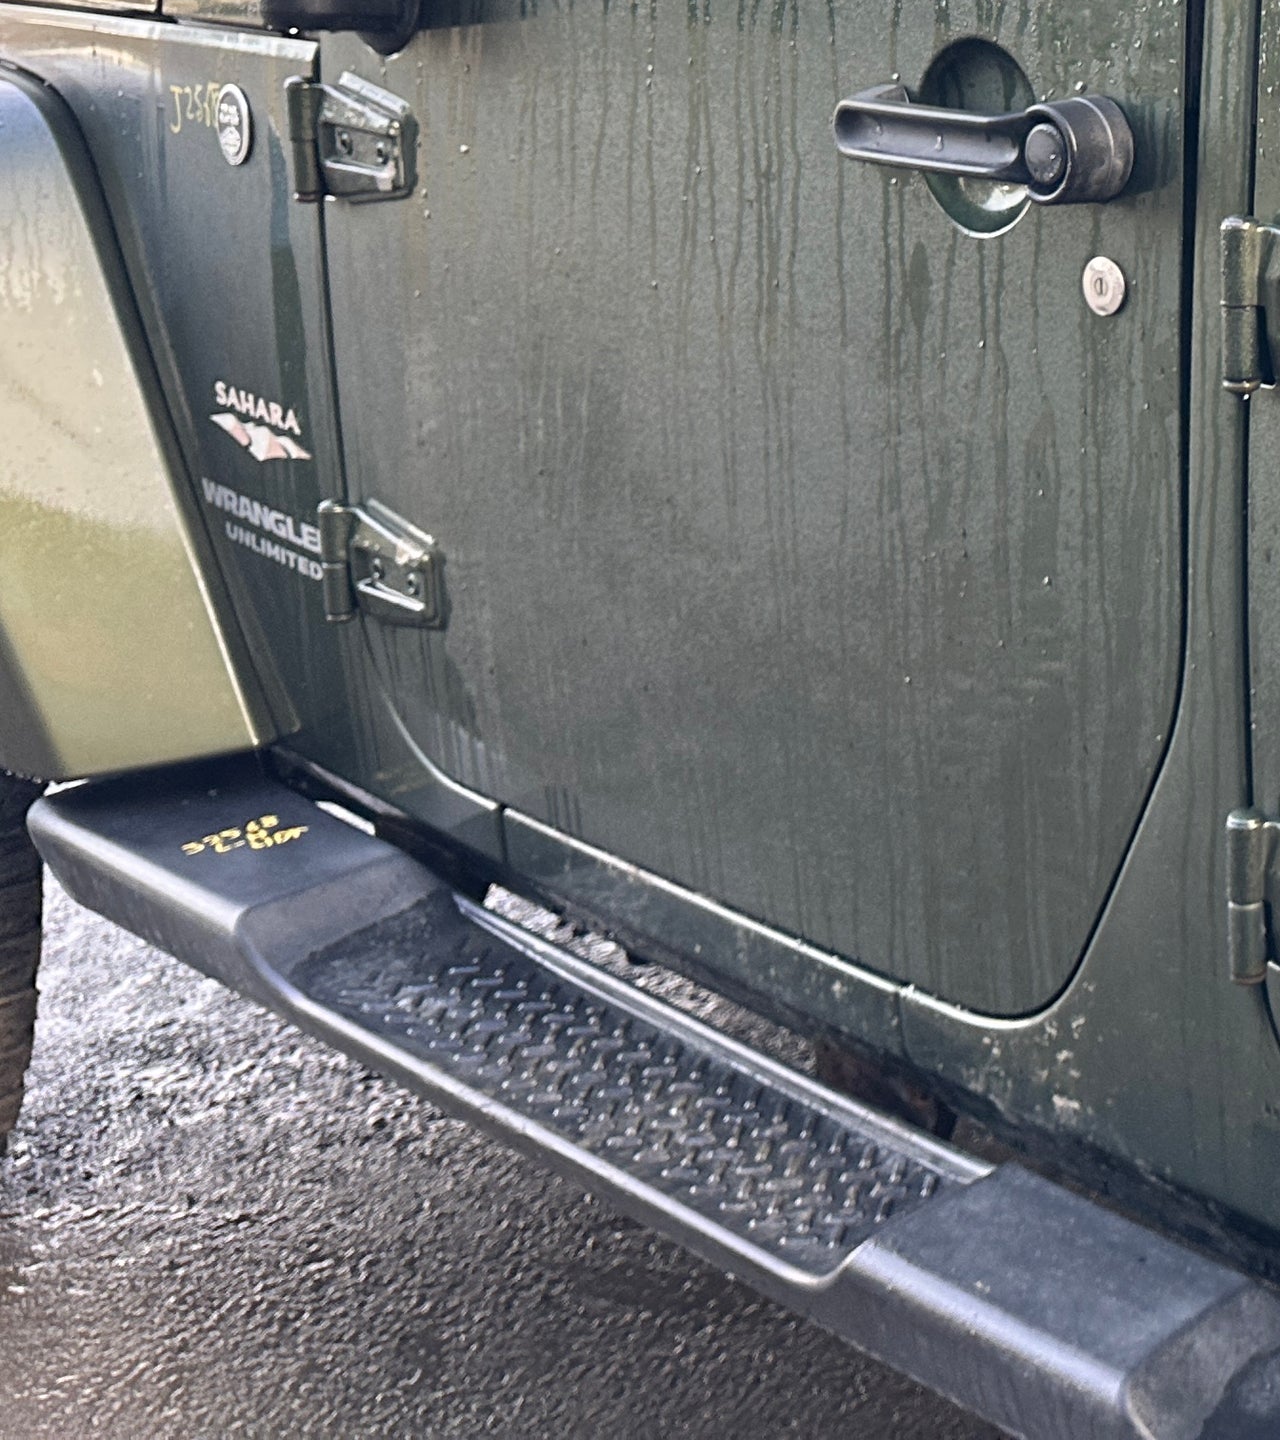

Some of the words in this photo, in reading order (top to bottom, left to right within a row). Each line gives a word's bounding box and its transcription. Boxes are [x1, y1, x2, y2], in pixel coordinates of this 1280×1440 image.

[214, 380, 301, 435] SAHARA
[201, 477, 322, 555] WRANGLE
[225, 520, 325, 581] UNLIMITED
